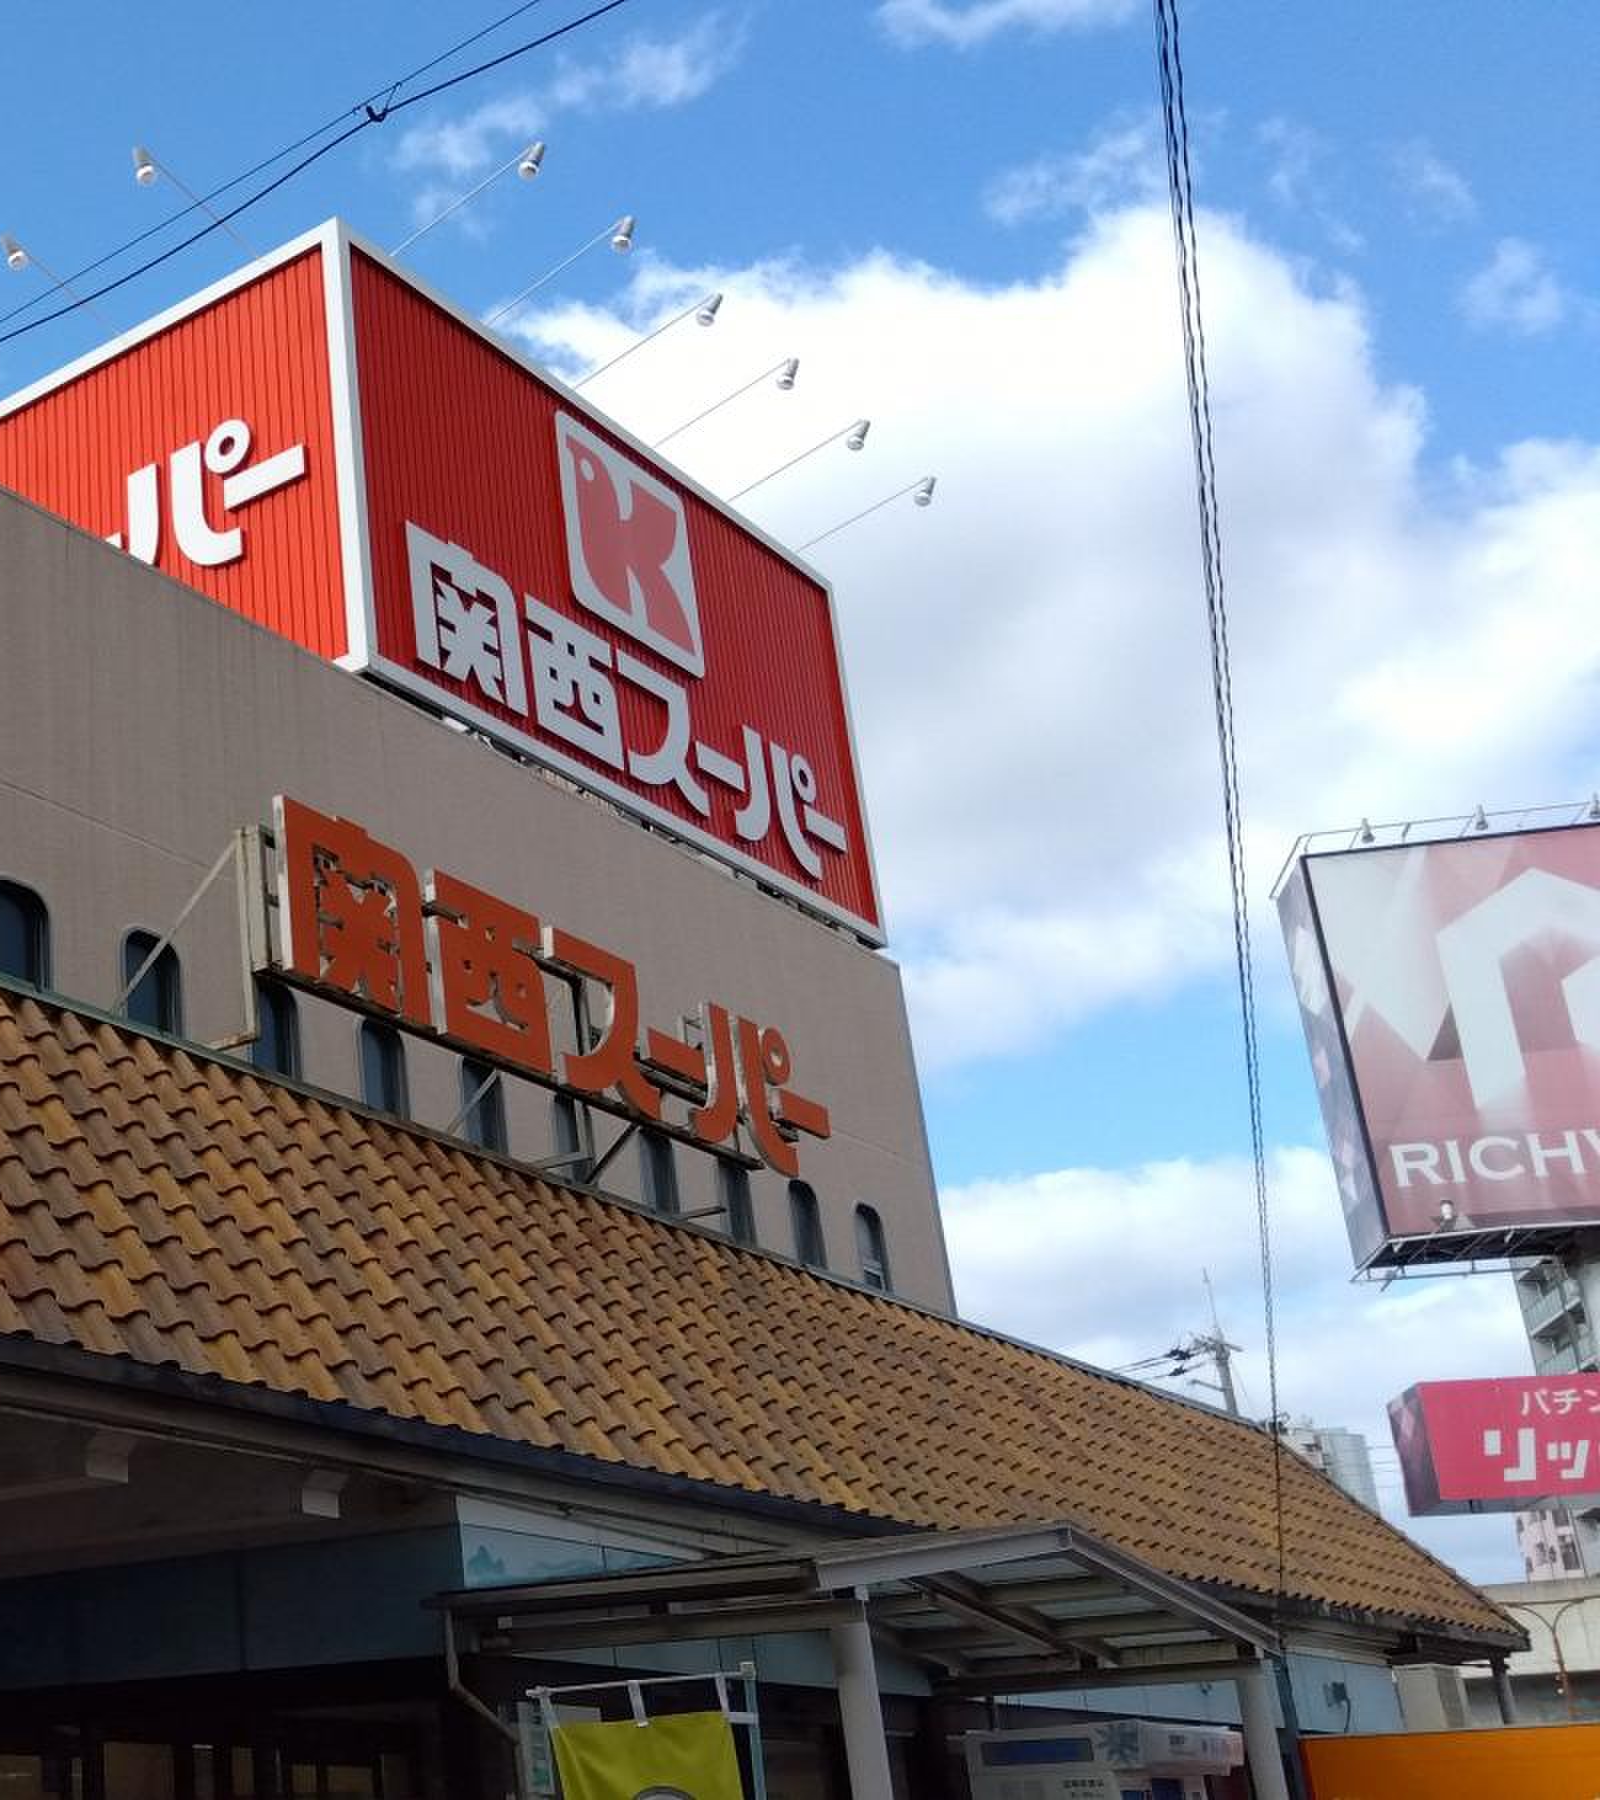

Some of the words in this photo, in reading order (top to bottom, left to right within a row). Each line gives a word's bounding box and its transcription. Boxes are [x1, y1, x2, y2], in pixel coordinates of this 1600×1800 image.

[104, 418, 305, 566] パー
[405, 519, 847, 880] 関西スーパー
[273, 794, 831, 1178] 関西スーパー
[1483, 1427, 1600, 1482] リッ
